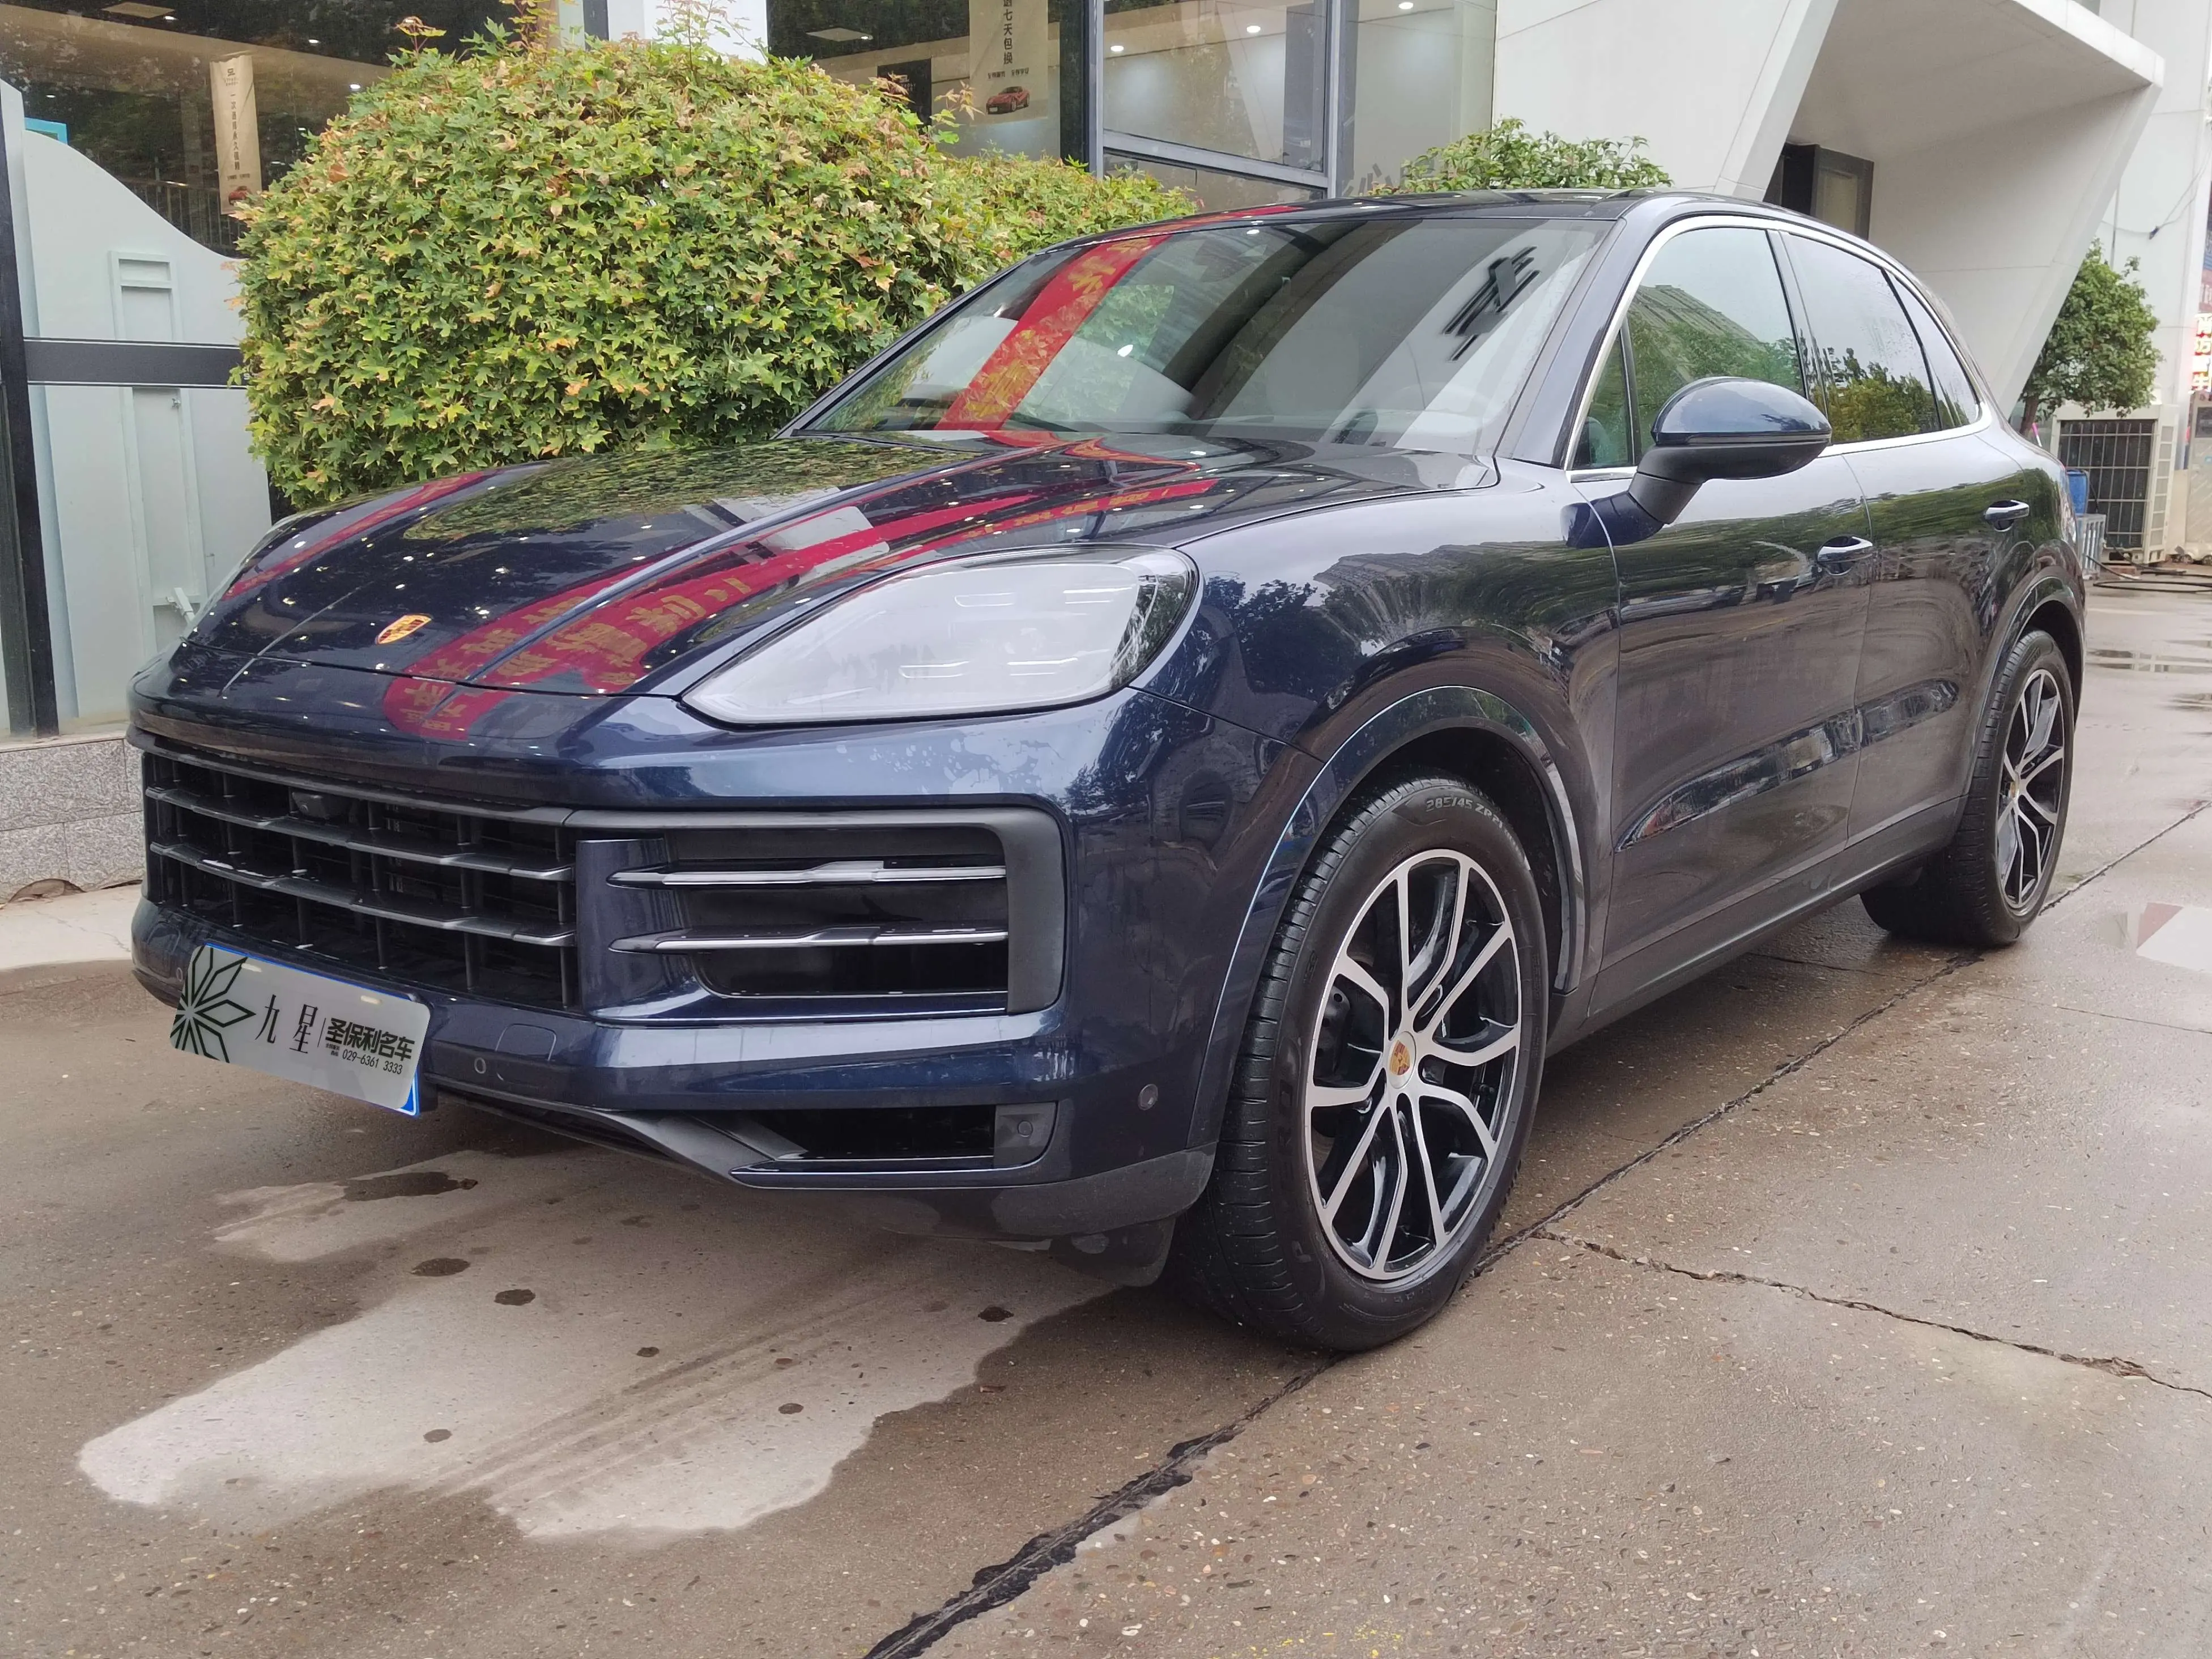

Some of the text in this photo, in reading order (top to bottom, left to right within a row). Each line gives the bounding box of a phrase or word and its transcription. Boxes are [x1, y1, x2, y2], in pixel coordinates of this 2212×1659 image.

[1426, 796, 1473, 812] 285/45
[254, 994, 318, 1054] 九星
[325, 1018, 415, 1061] 圣保利名车
[342, 1049, 380, 1068] 029-6361
[383, 1060, 403, 1075] 3333
